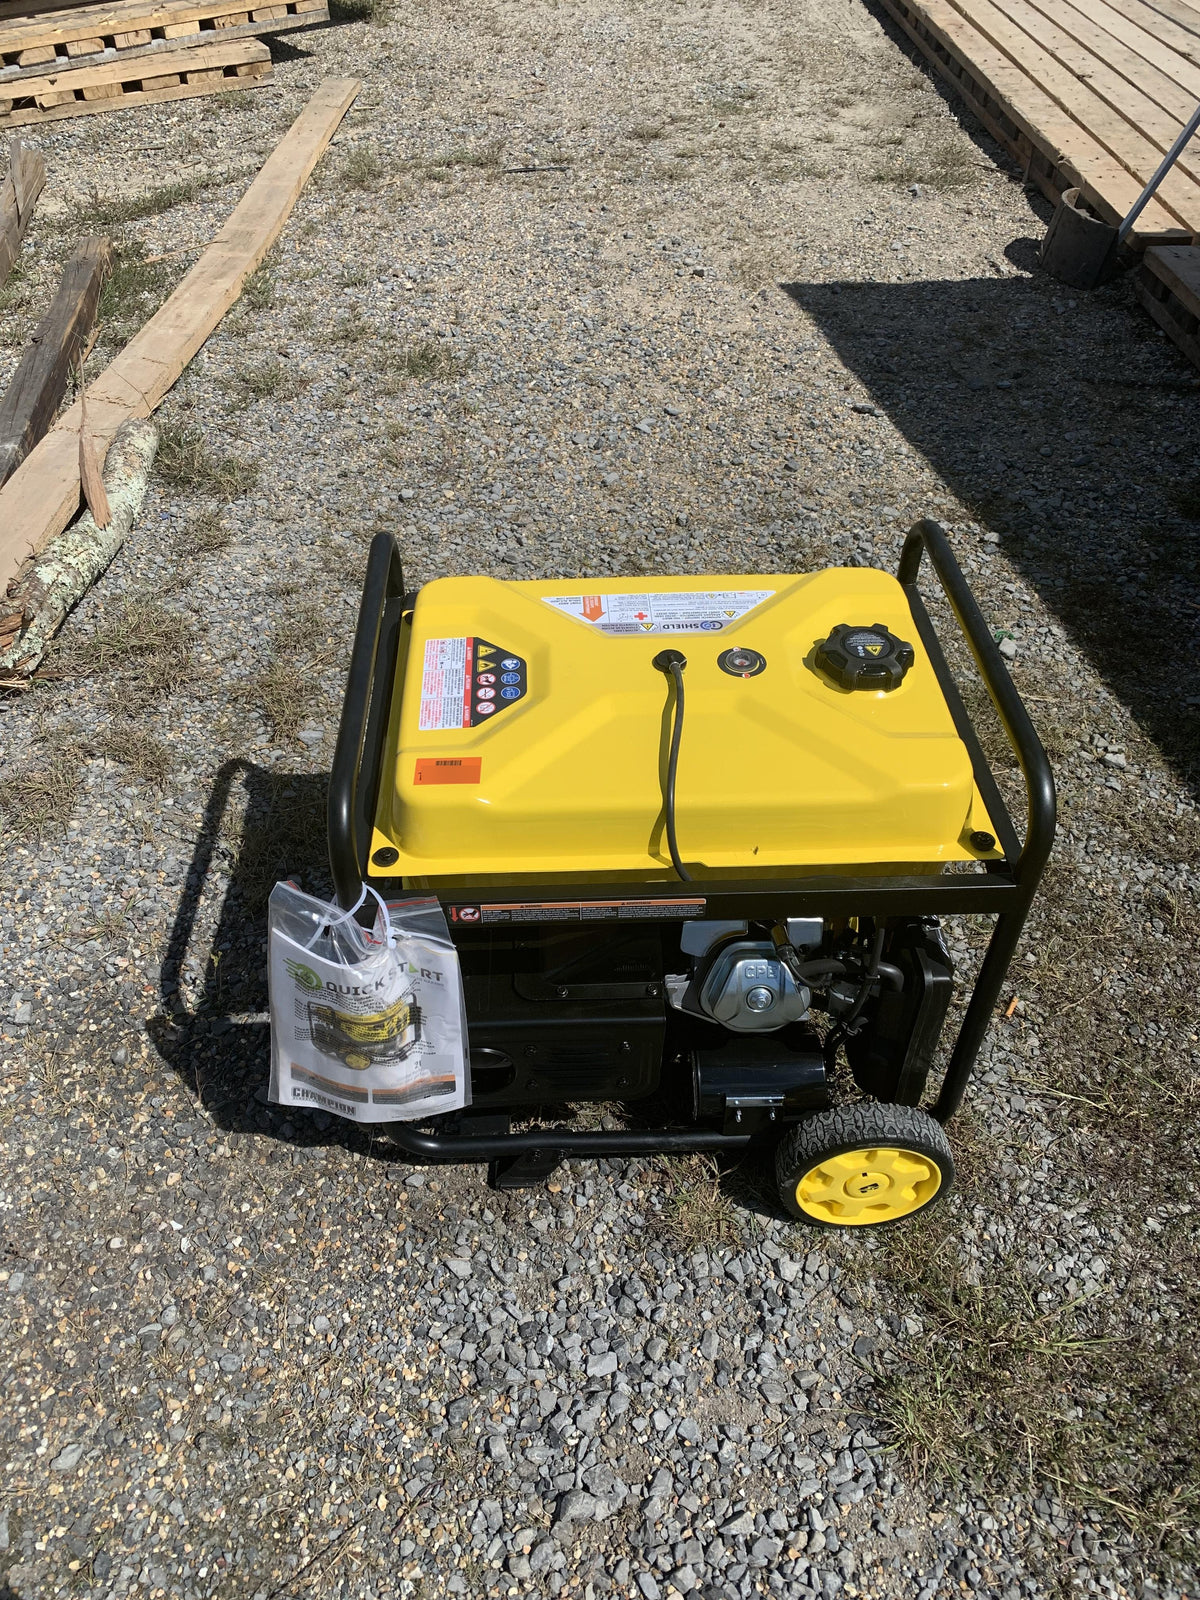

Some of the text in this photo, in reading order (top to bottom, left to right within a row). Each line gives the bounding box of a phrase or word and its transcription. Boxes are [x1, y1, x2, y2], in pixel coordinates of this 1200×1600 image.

[744, 965, 777, 979] CPE
[326, 976, 385, 996] QUICK
[292, 1087, 356, 1115] CHAMPION
